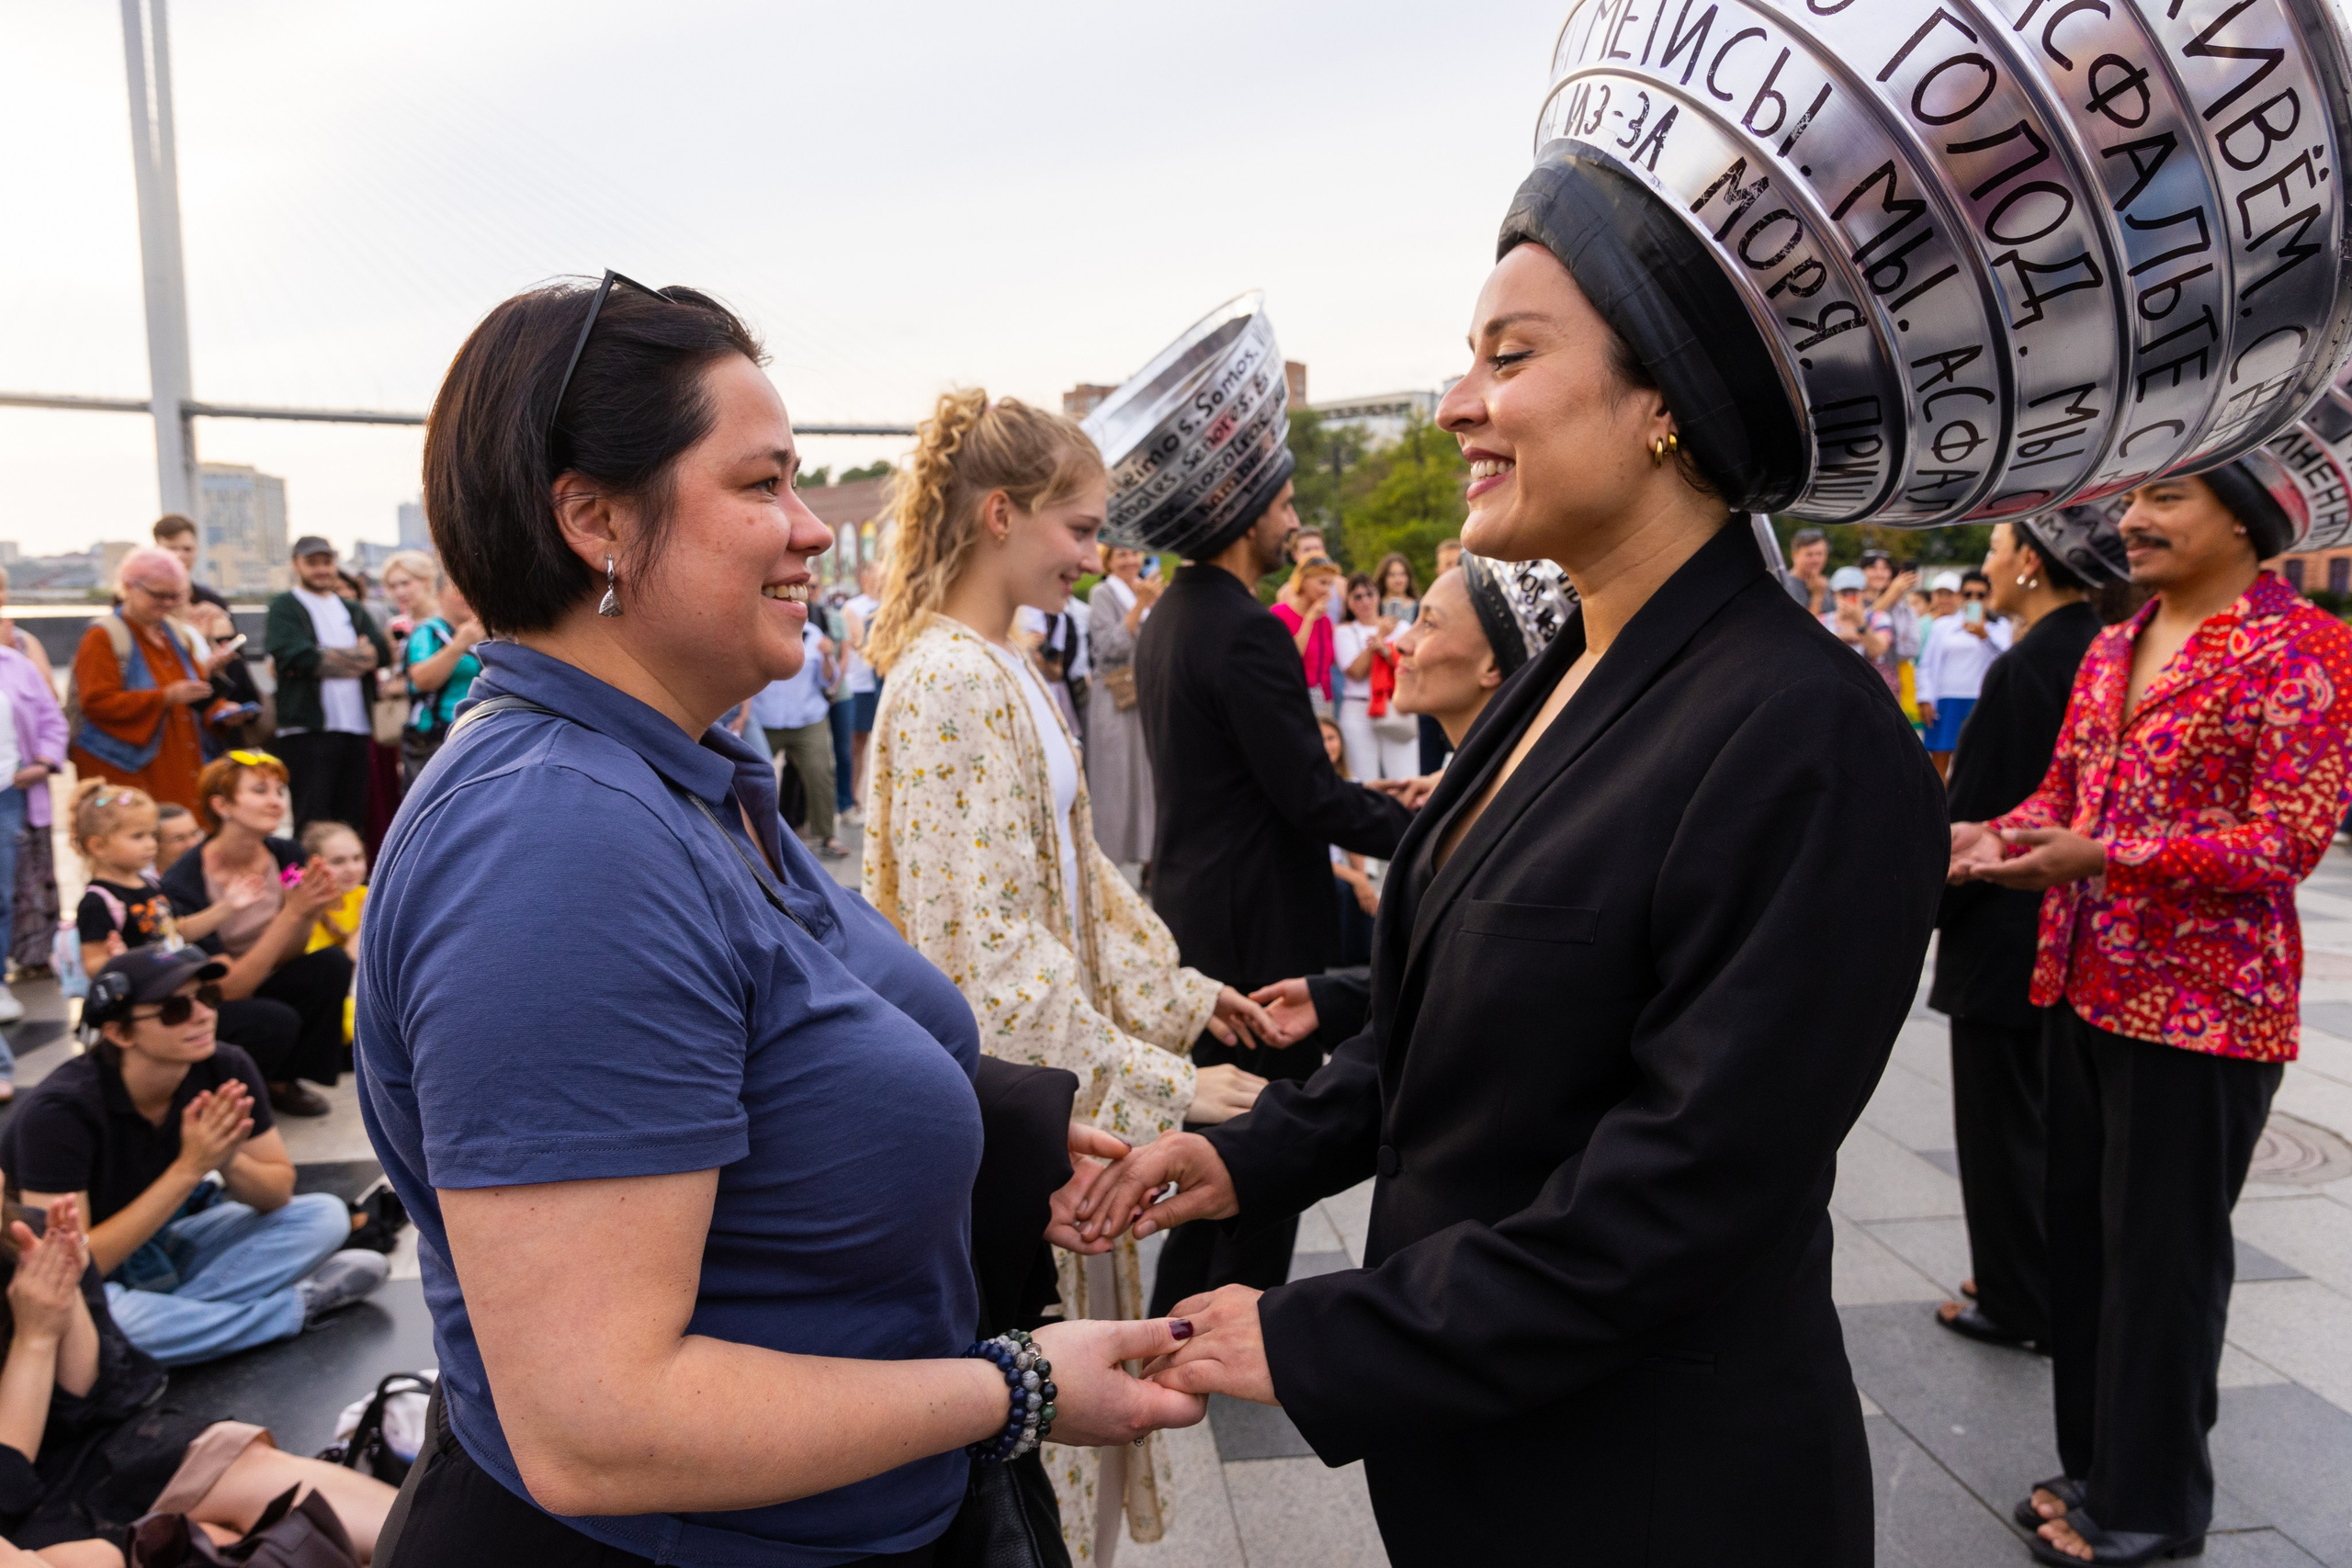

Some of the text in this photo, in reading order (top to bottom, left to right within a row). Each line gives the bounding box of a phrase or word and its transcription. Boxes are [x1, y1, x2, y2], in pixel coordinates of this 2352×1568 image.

[1564, 83, 1679, 173] ИЗ-ЗА
[1690, 157, 1868, 370] МОРЯ.
[1876, 7, 2104, 356] ГОЛОД.
[2008, 382, 2100, 471] МЫ
[2166, 0, 2330, 318] ИВЁМ.
[1830, 159, 1960, 333] МЫ.
[1905, 344, 1996, 513] АСФАЛ
